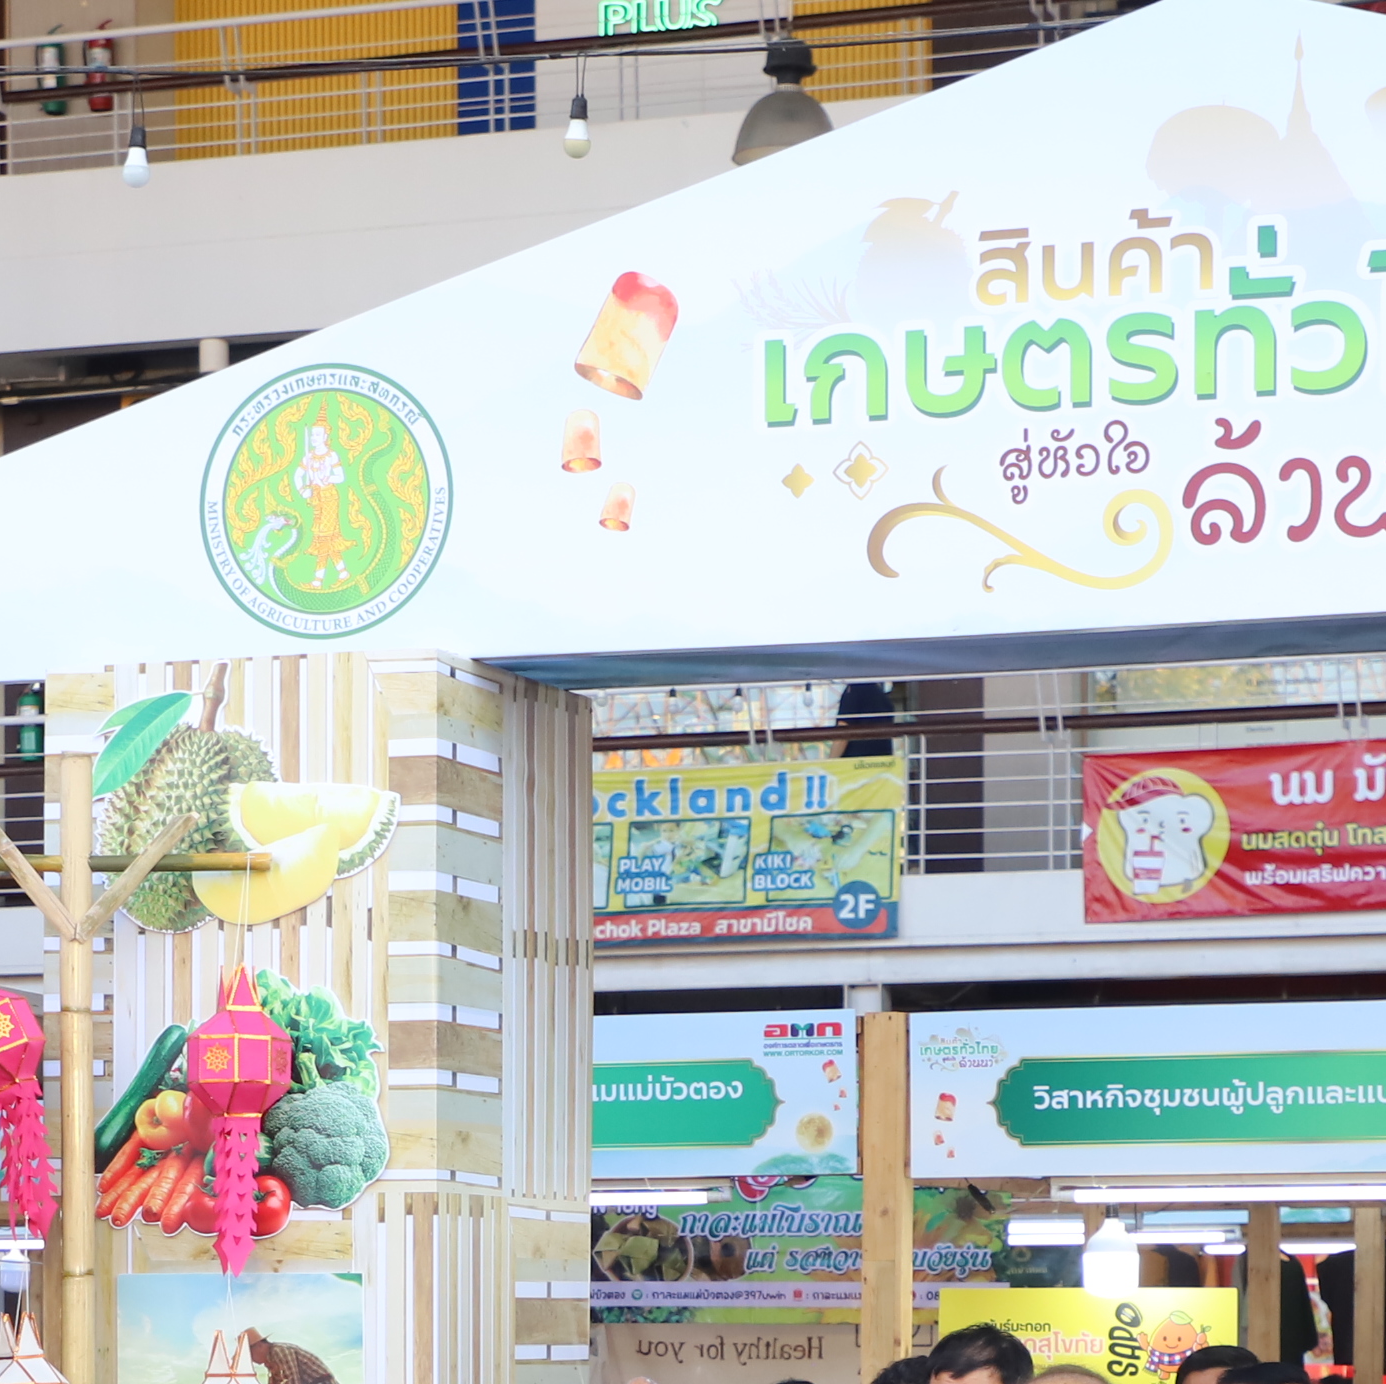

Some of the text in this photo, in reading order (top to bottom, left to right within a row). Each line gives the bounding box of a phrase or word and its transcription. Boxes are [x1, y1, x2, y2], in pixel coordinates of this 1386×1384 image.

[598, 0, 722, 36] PLUS
[975, 208, 1215, 307] สินค้า
[207, 500, 236, 577] MINISTRY
[247, 594, 353, 632] AGRICULTURE
[356, 600, 388, 627] AND
[388, 487, 447, 604] COOPERATIVES
[1269, 770, 1334, 806] นม
[619, 857, 664, 873] PLAY
[755, 854, 792, 870] KIKI
[616, 876, 672, 893] MOBIL
[753, 872, 813, 889] BLOCK
[838, 894, 876, 919] 2F
[594, 919, 702, 940] chok Plaza
[714, 911, 813, 936] สาขามีโชค
